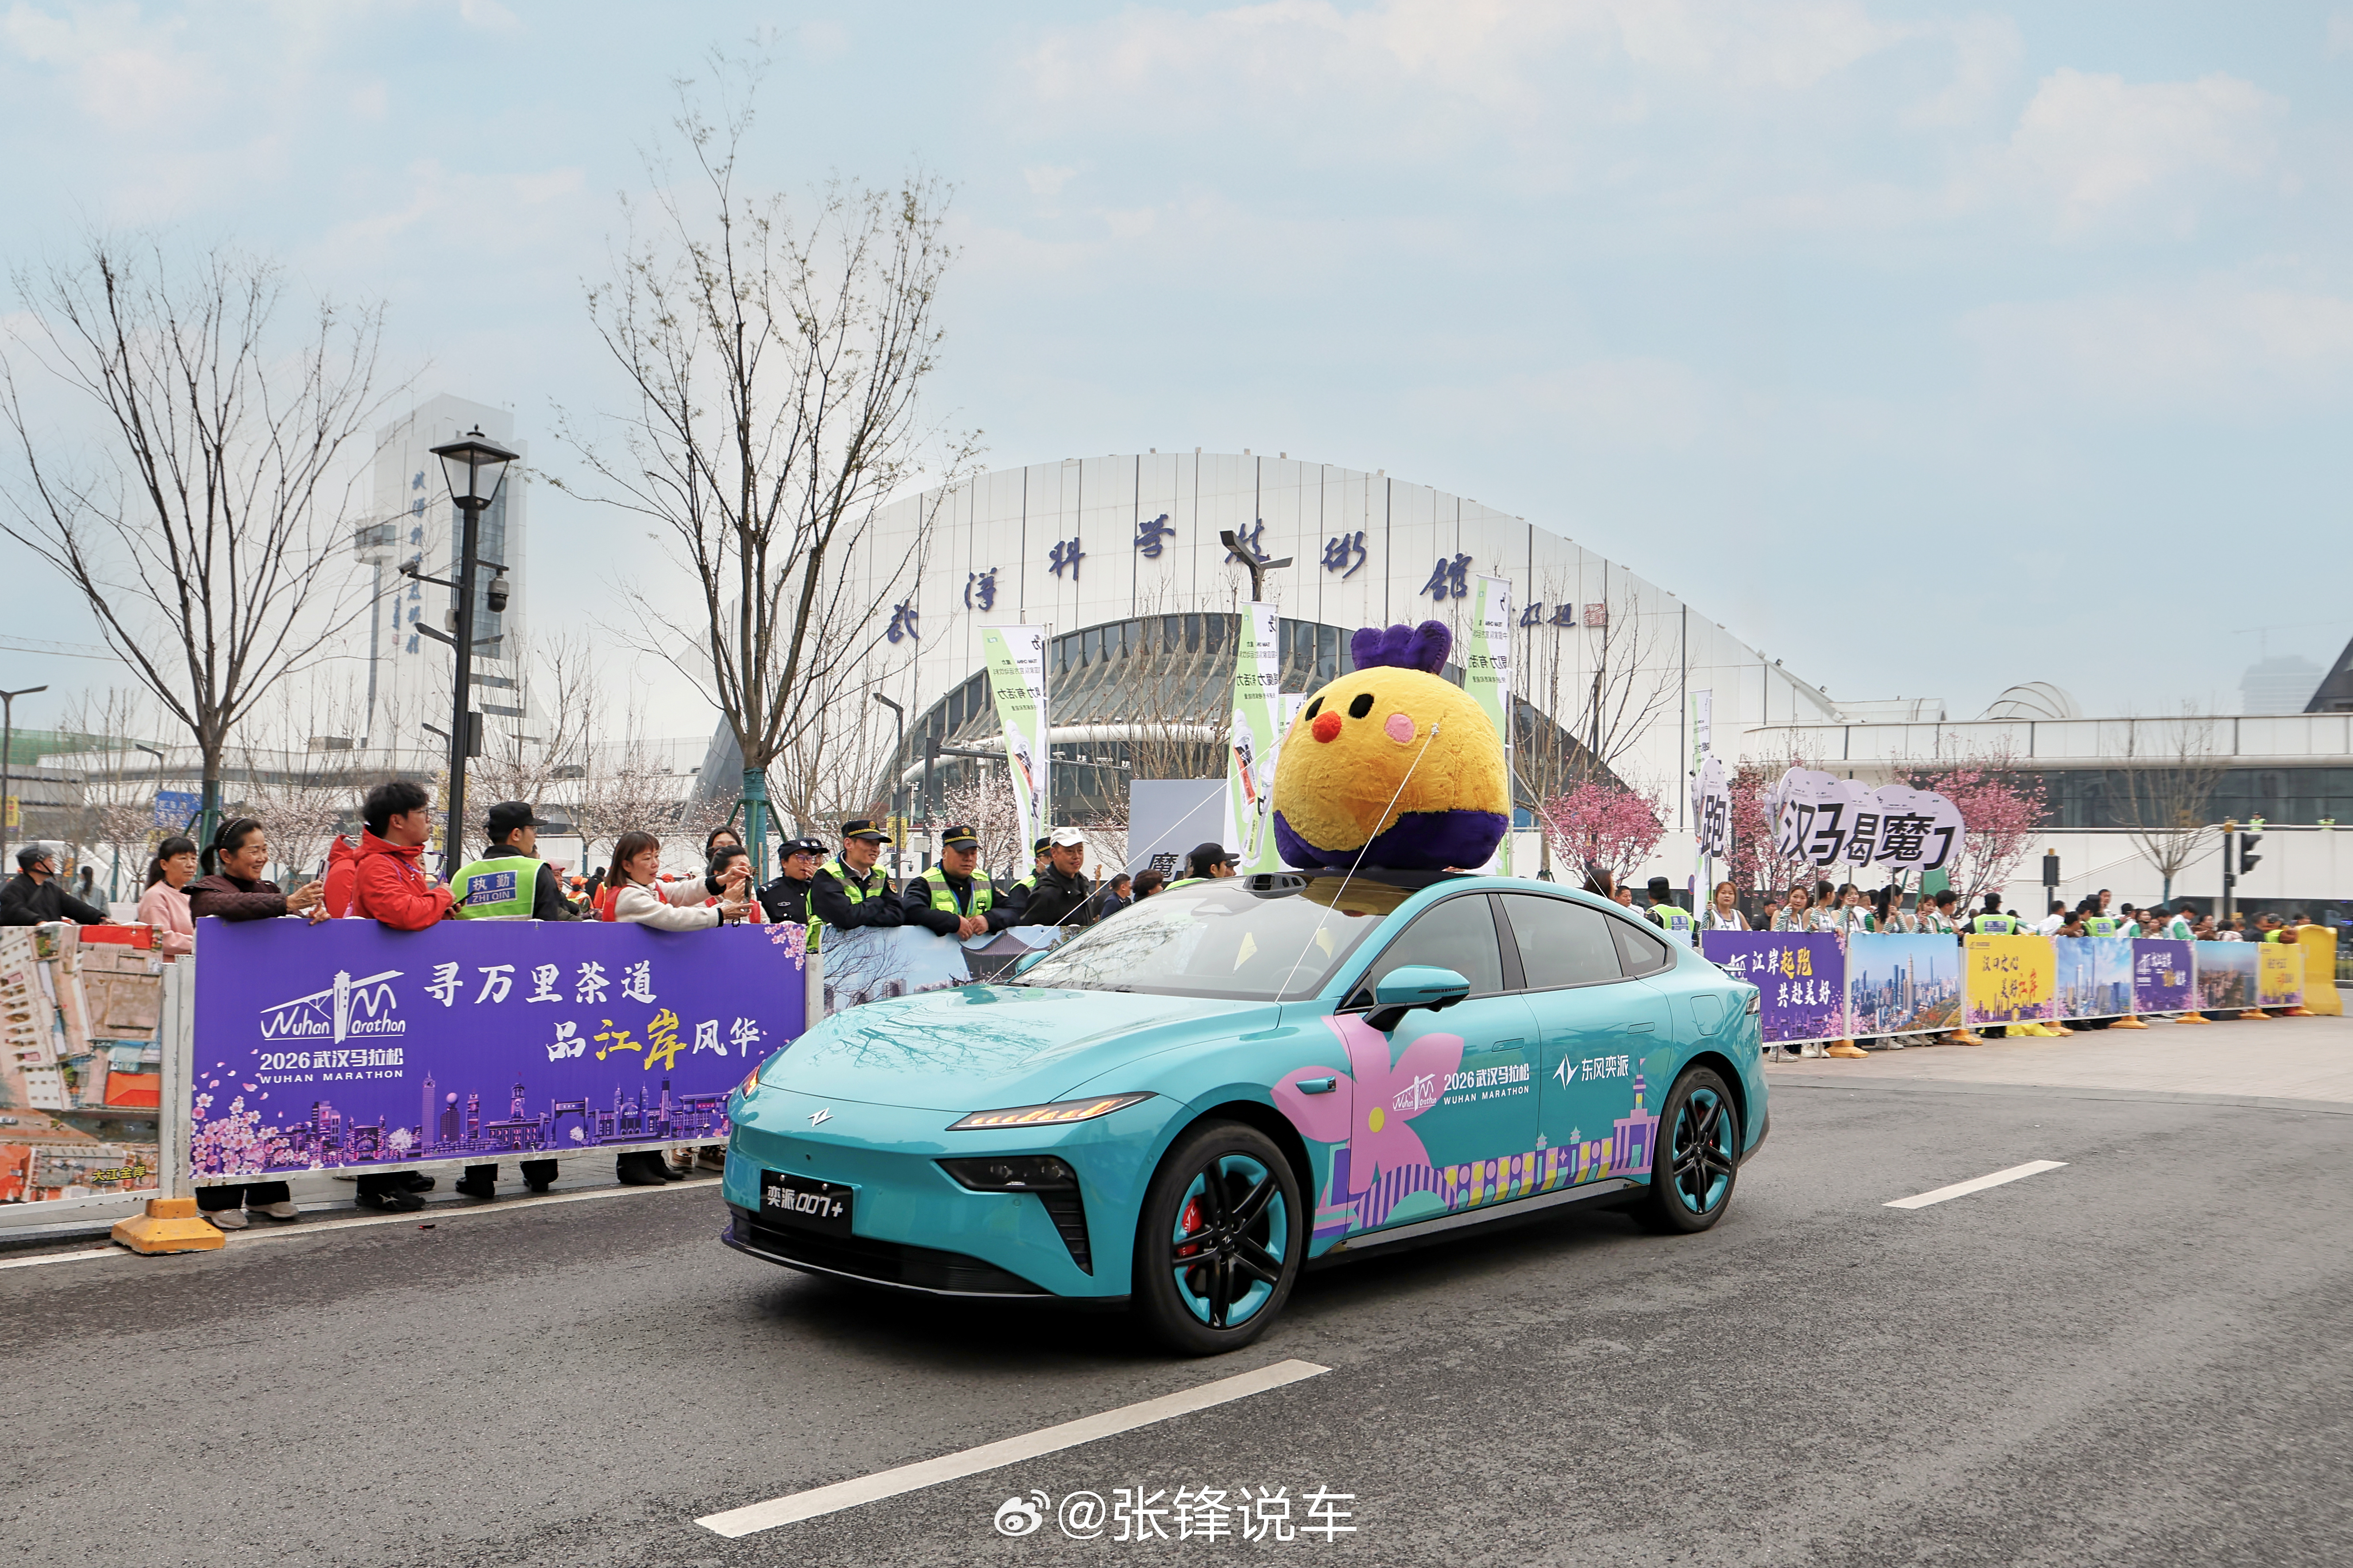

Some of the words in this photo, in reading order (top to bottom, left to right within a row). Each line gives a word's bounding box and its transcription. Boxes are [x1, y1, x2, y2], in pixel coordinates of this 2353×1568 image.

[1701, 794, 1727, 858] 跑
[472, 874, 510, 891] 执勤
[472, 894, 489, 903] ZHI
[491, 890, 509, 900] QIN
[424, 960, 657, 1007] 寻万里茶道
[1777, 979, 1832, 1008] 共赴美好
[260, 1006, 330, 1038] Wuhan
[546, 1008, 760, 1071] 品江岸风华
[260, 1074, 313, 1084] WUHAN
[323, 1070, 403, 1081] MARATHON
[1582, 1055, 1629, 1081] 东风奕派
[1443, 1093, 1477, 1105] WUHAN
[1482, 1086, 1529, 1100] MARATHON
[92, 1165, 146, 1182] 大江金岸
[768, 1186, 844, 1217] 奕派007+
